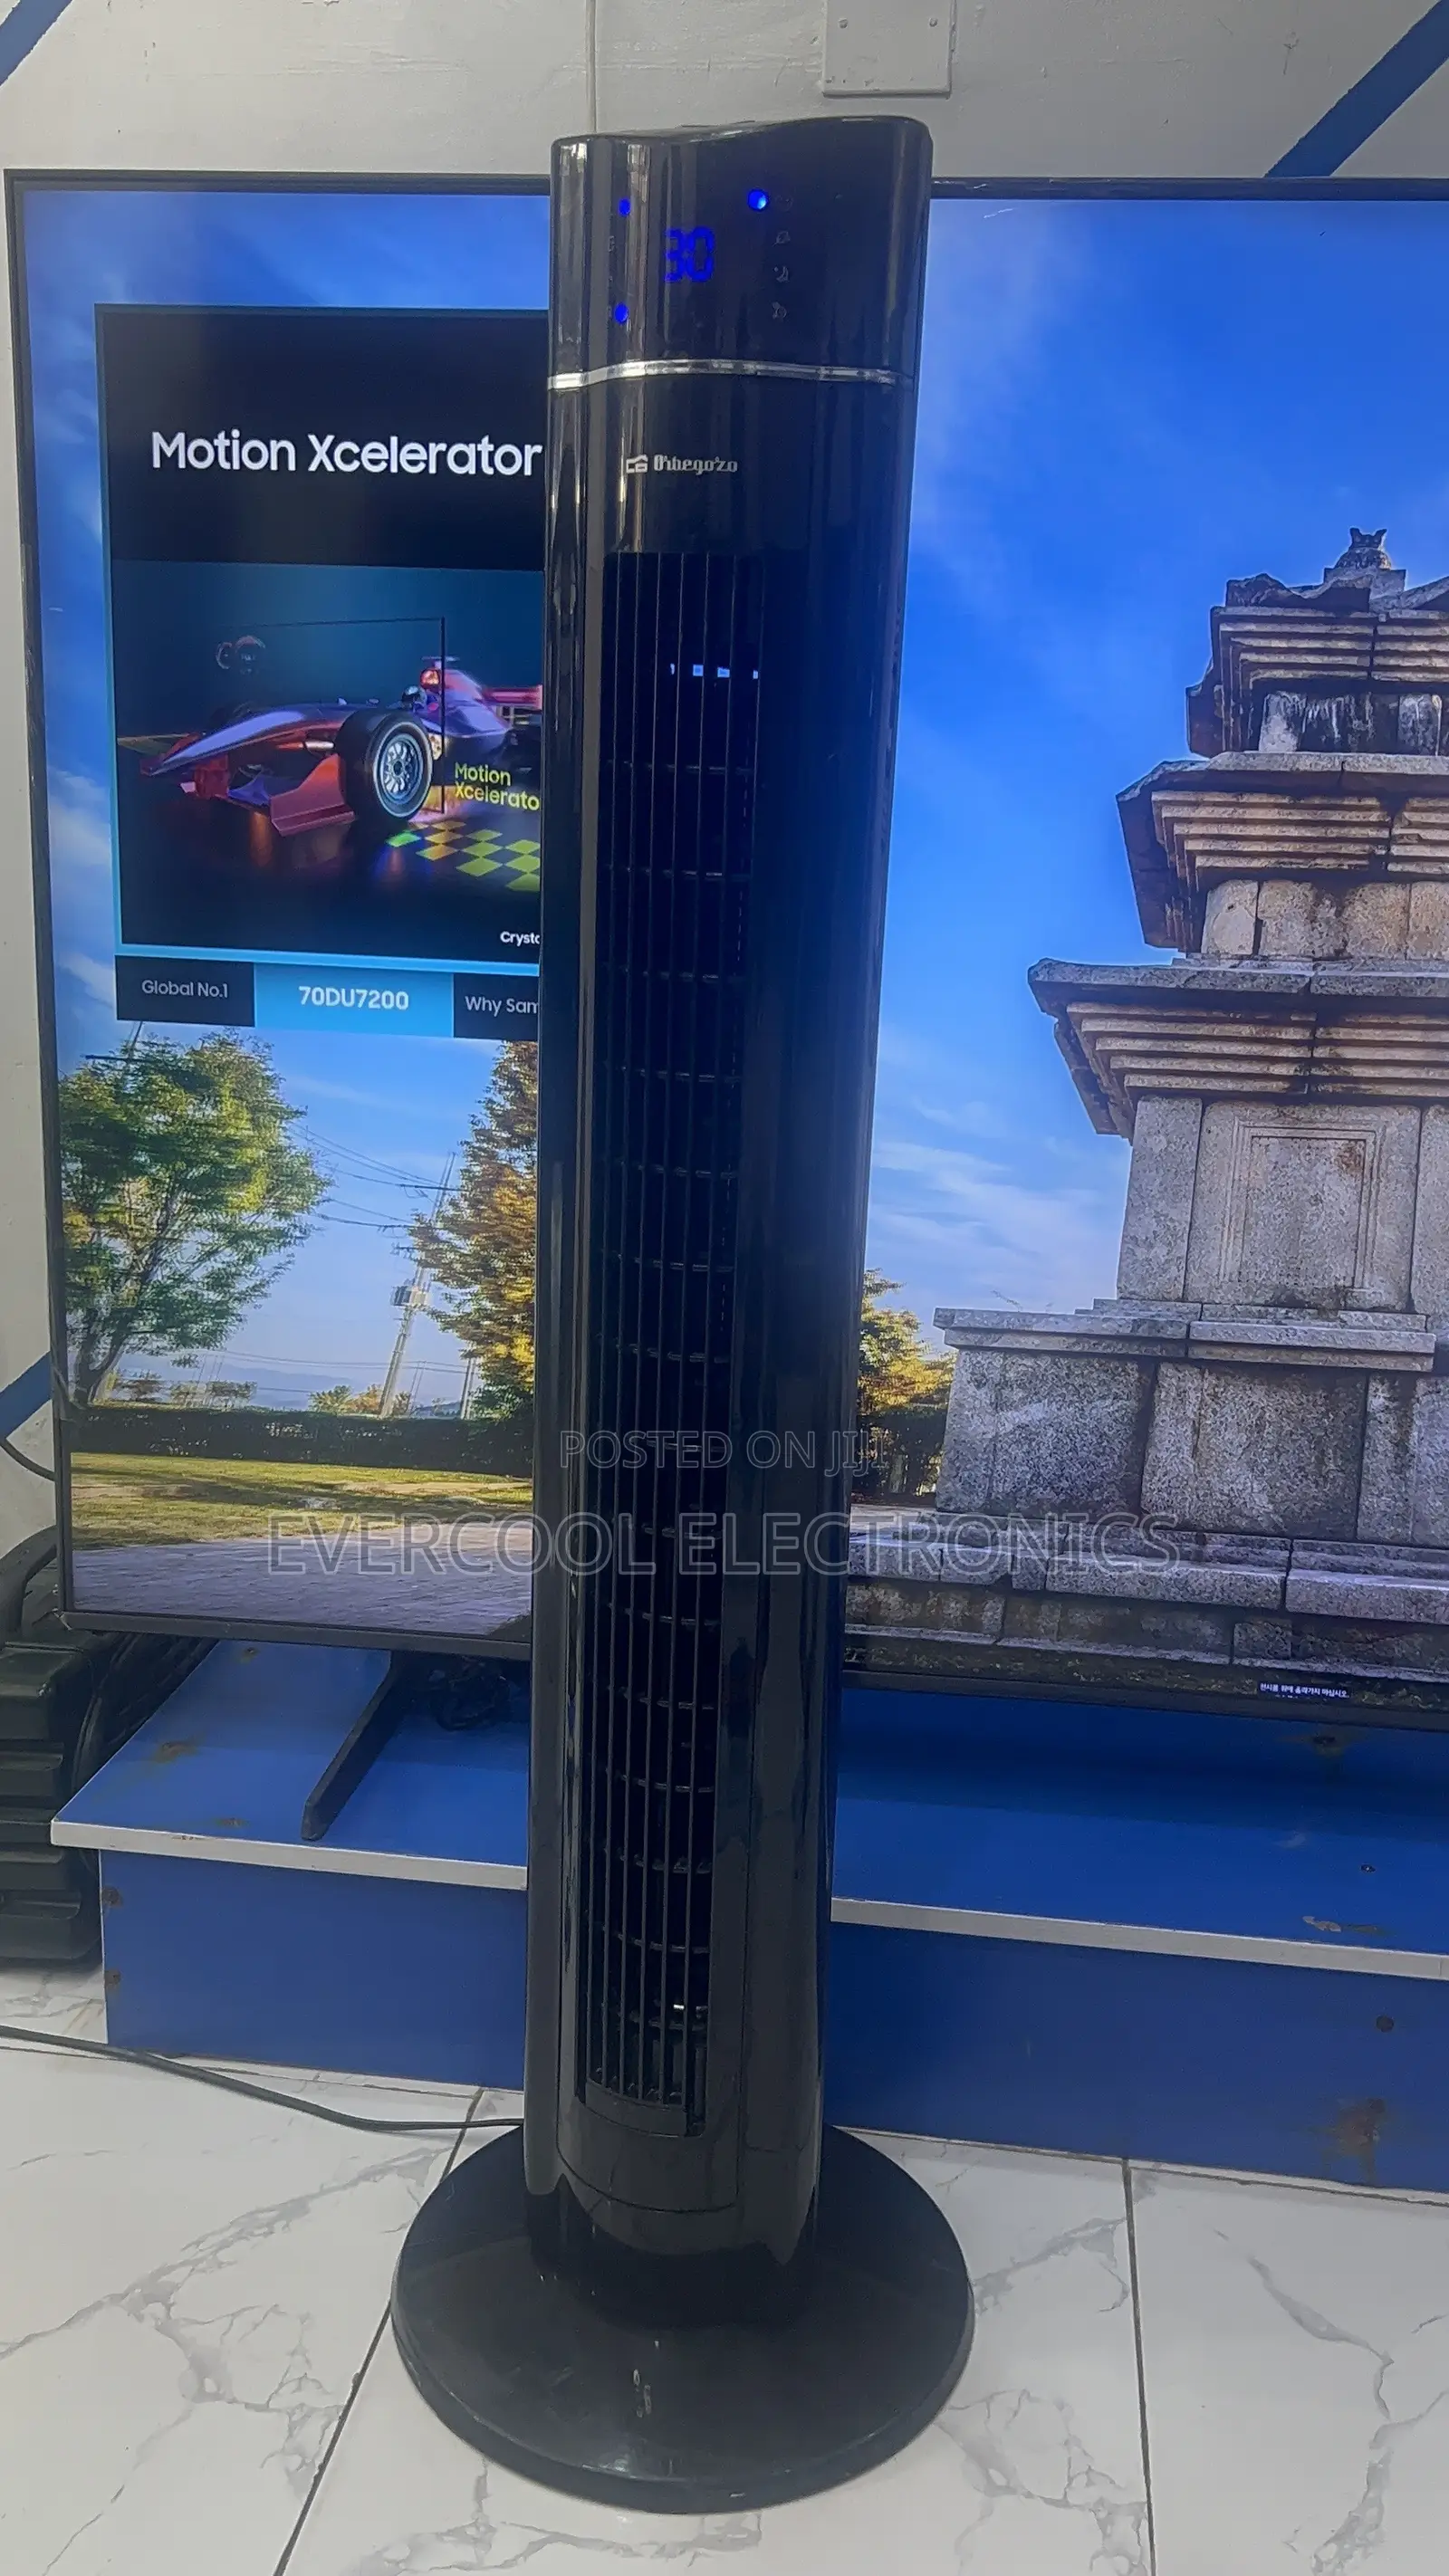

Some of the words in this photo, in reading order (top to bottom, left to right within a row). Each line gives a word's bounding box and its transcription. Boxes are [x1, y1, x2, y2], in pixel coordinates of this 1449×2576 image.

[665, 227, 715, 282] 30
[151, 428, 296, 471] Motion
[308, 434, 542, 476] Xcelerator
[455, 762, 511, 786] Motion
[455, 780, 540, 811] Xcelerato
[141, 980, 194, 996] Global
[197, 982, 228, 999] No.1
[299, 985, 409, 1010] 70DU7200
[465, 996, 503, 1017] Why
